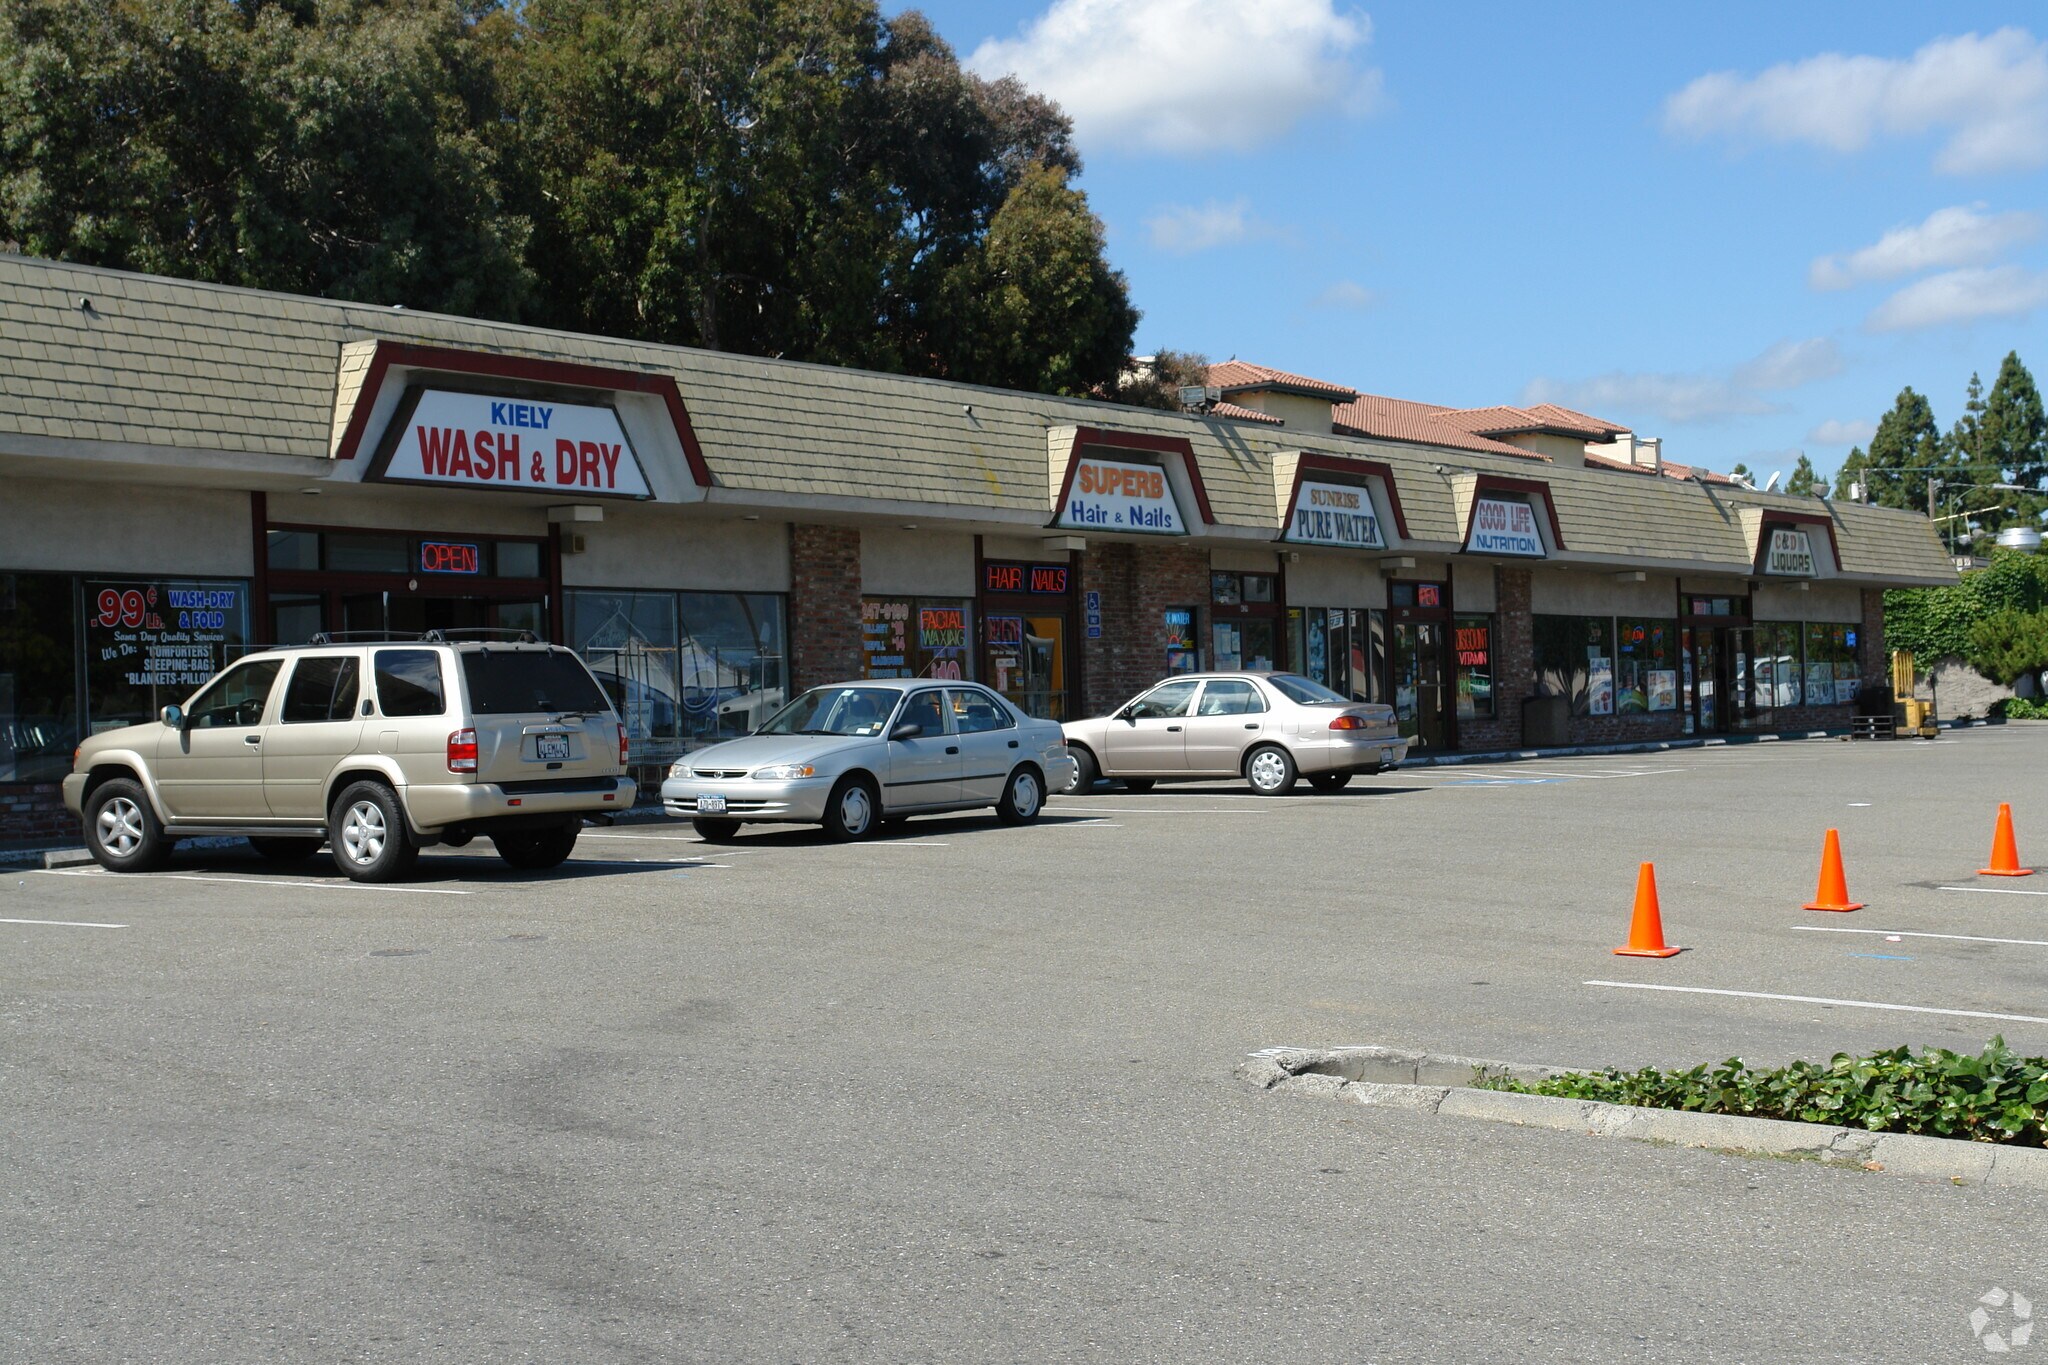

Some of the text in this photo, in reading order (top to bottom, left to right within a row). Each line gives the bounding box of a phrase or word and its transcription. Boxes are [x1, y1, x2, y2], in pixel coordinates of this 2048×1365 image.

[491, 402, 553, 429] KIELY
[417, 426, 621, 489] WASH & DRY
[1079, 464, 1164, 499] SUPERB
[1310, 488, 1360, 509] SUNRISE
[1071, 500, 1172, 528] Hair & Nails
[1478, 502, 1531, 533] GOOD LIFE
[1297, 508, 1377, 544] PURE WATER
[1476, 534, 1536, 551] NUTRITION
[423, 544, 477, 572] OPEN
[1771, 552, 1811, 573] LIQUORS
[988, 567, 1022, 590] HAIR
[1031, 569, 1065, 592] NAILS
[168, 590, 235, 608] WASH-DRY
[179, 611, 225, 628] & FOLD
[921, 611, 966, 629] FACIAL
[114, 631, 224, 643] Same Day Quality Services
[922, 629, 965, 646] WAXING
[1456, 628, 1488, 650] DISCOUNT
[1632, 629, 1645, 641] ATM
[101, 643, 137, 661] We Do:
[1459, 651, 1487, 665] VITAMIN
